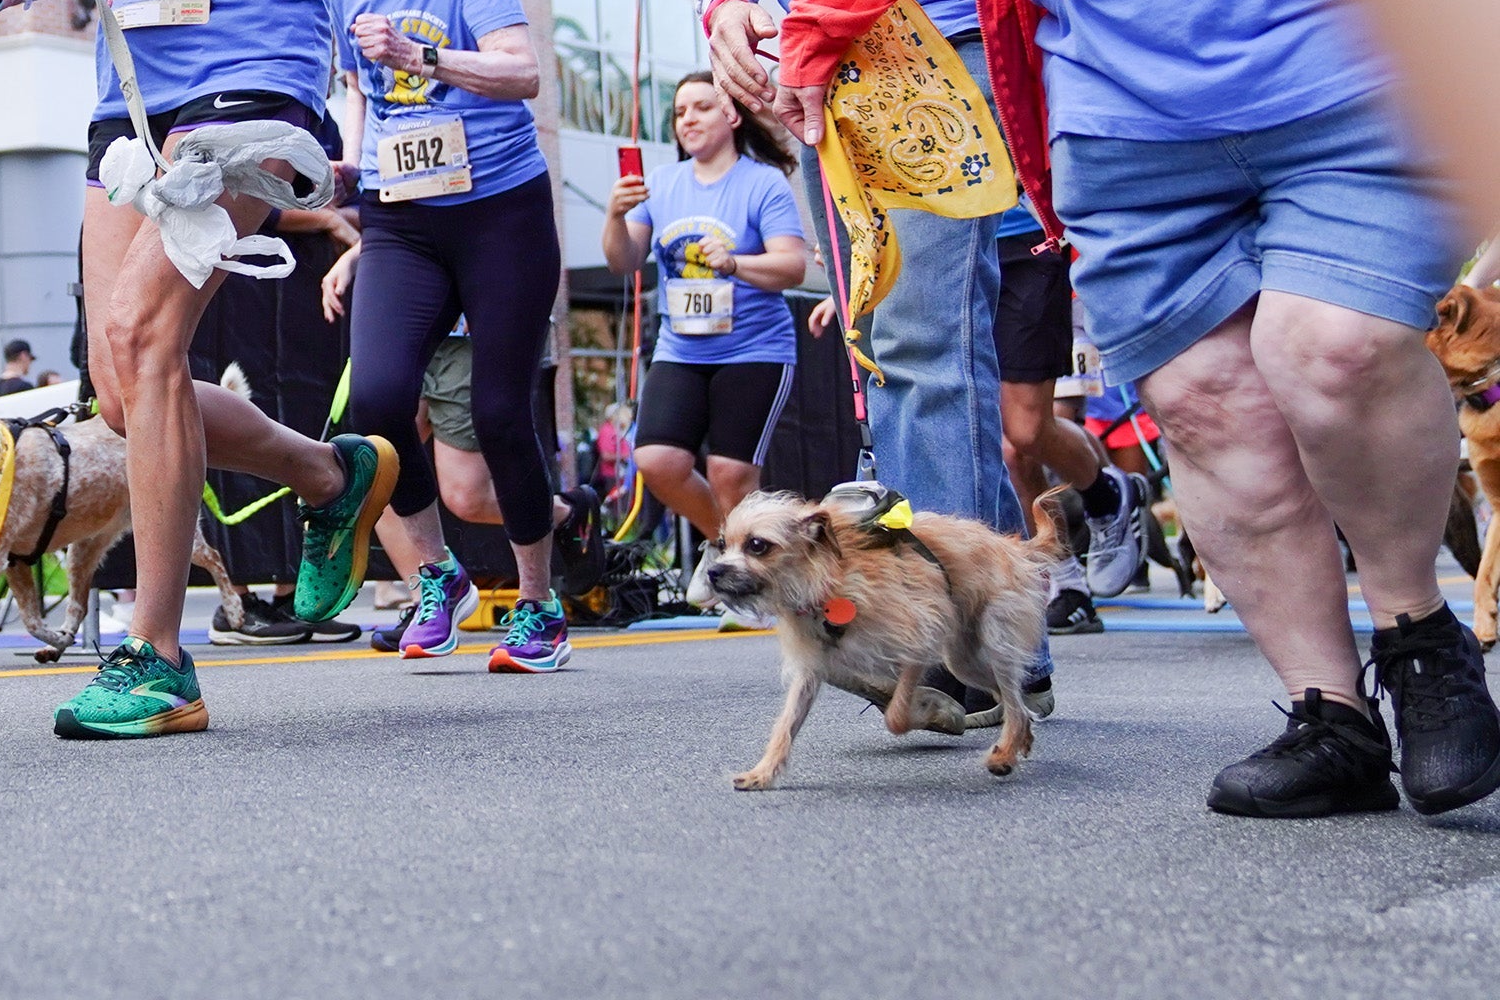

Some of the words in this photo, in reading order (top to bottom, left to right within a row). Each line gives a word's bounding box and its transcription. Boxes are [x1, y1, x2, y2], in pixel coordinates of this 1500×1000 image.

[401, 19, 452, 49] STRUT
[393, 137, 446, 172] 1542
[684, 293, 712, 314] 760
